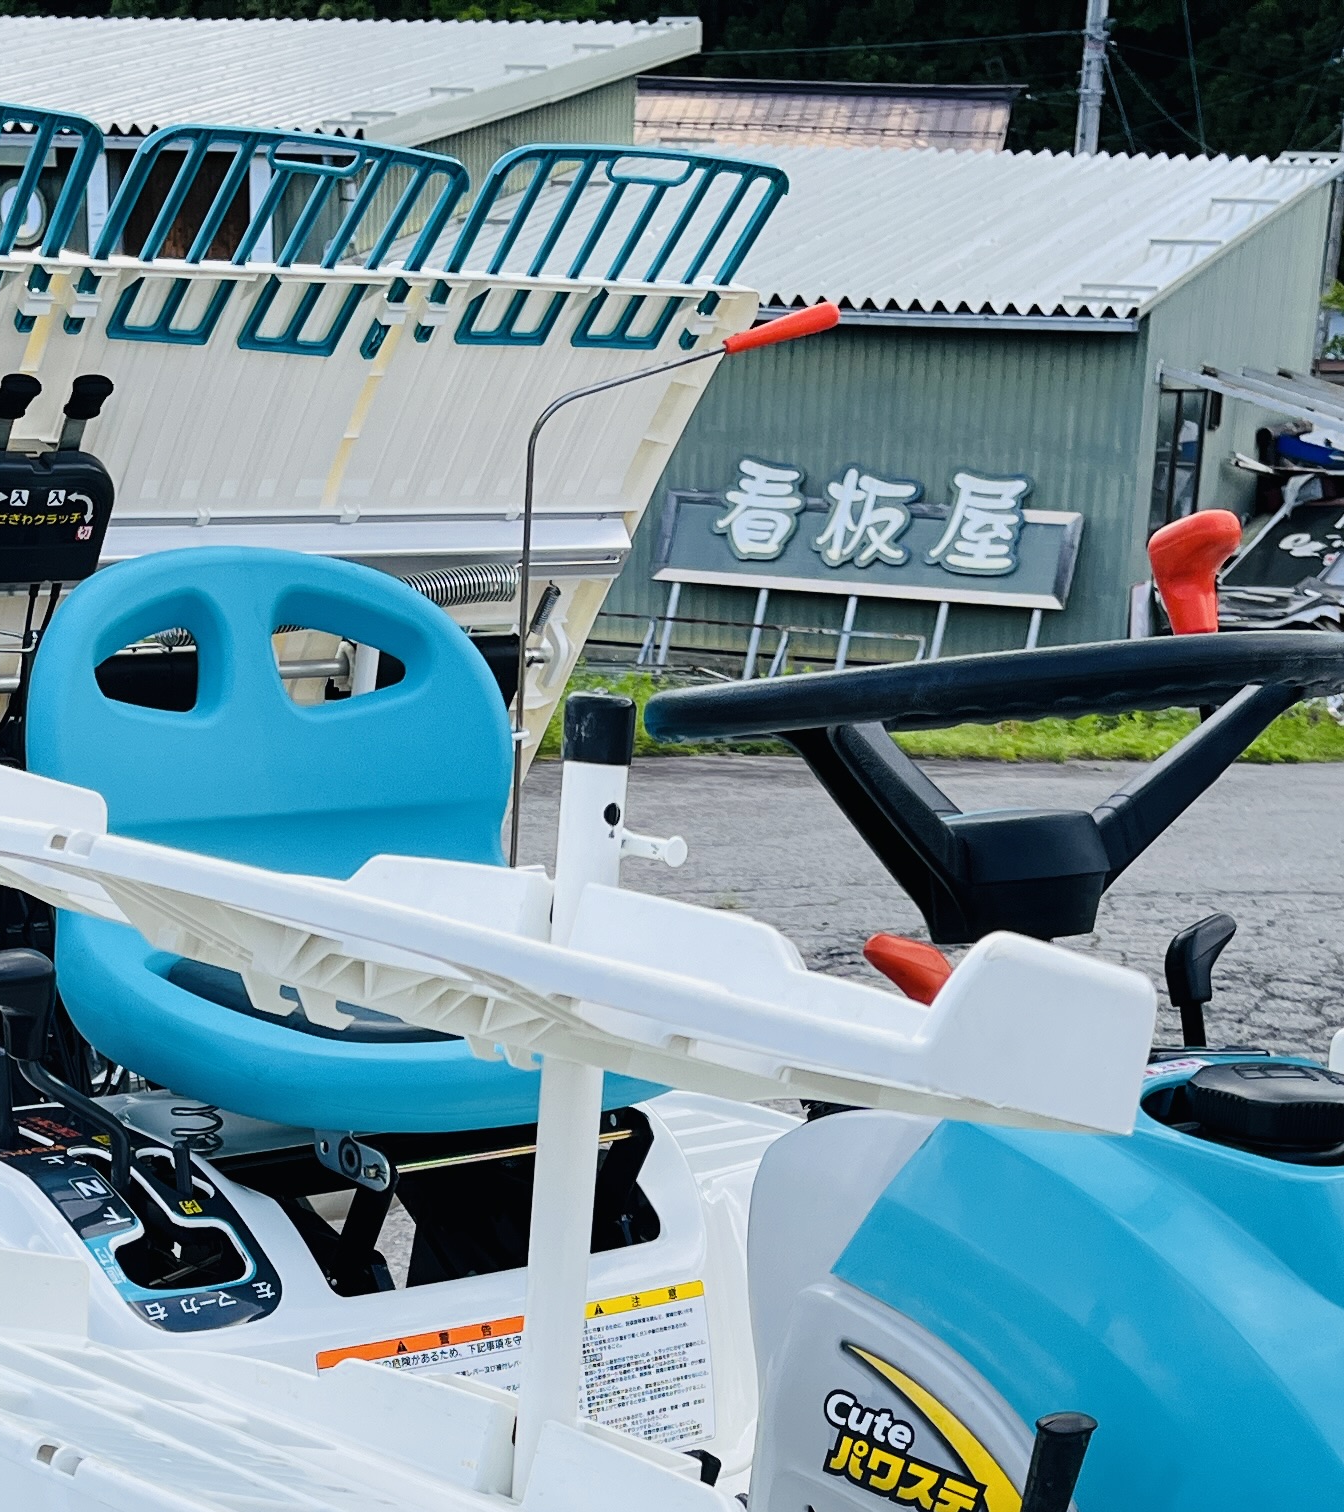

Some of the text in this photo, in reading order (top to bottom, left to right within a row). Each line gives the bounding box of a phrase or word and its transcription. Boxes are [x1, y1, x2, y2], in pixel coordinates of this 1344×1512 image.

[11, 490, 27, 505] 入
[48, 490, 64, 505] 入
[714, 457, 1029, 571] 看板屋
[76, 526, 93, 541] 切
[75, 1179, 107, 1198] N
[825, 1393, 912, 1450] Cute
